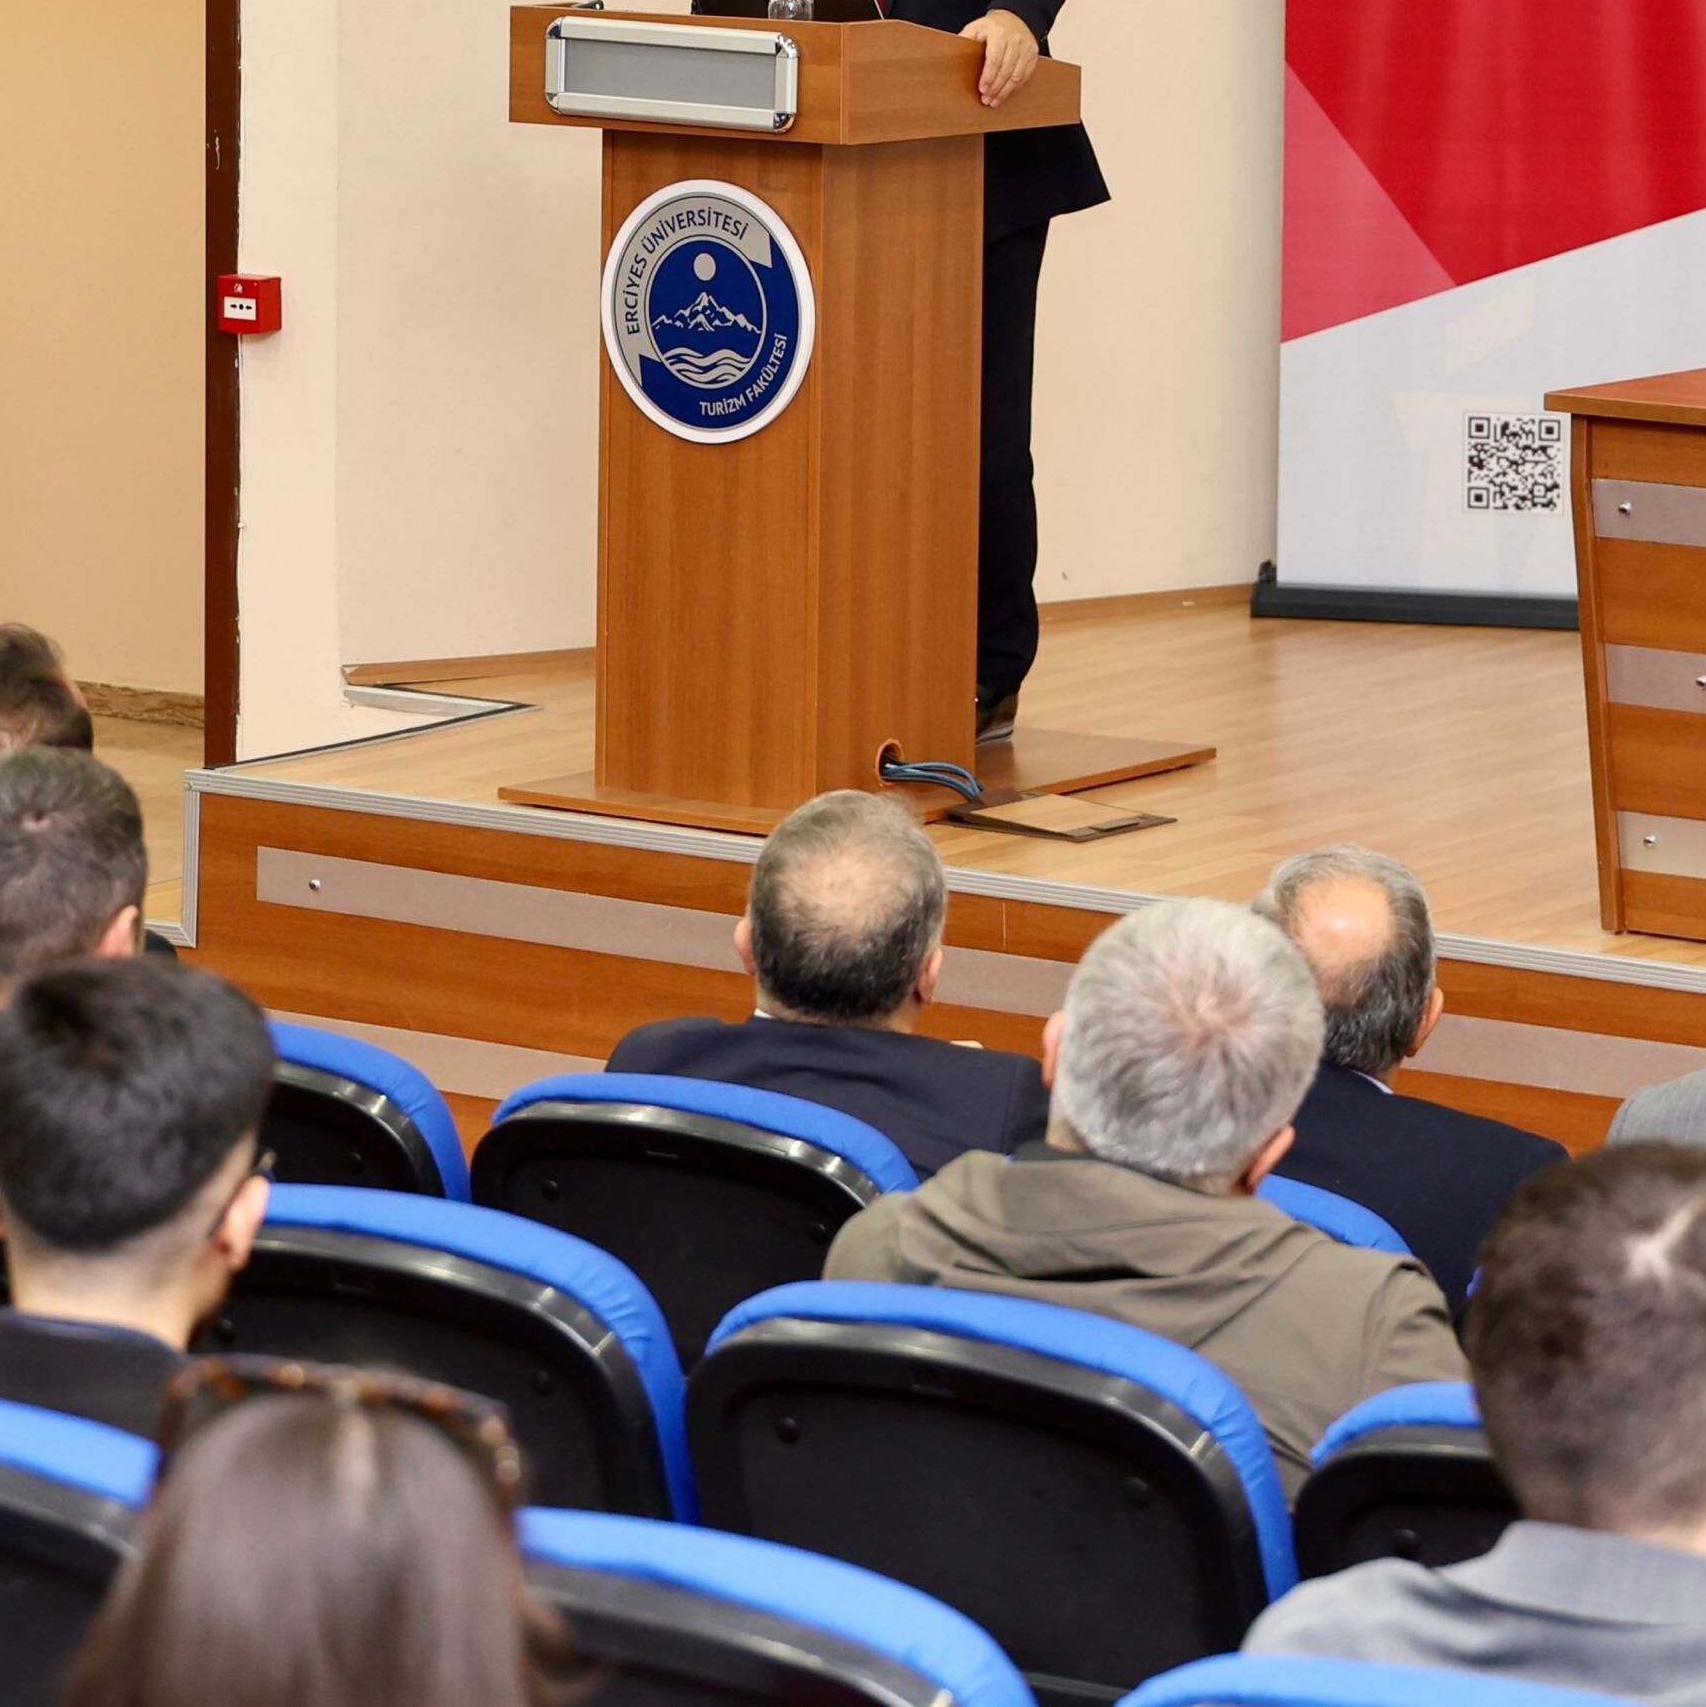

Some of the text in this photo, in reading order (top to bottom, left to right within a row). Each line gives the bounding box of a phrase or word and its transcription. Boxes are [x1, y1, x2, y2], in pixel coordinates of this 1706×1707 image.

[622, 206, 749, 335] ERCİYES ÜNİVERSİTESİ
[699, 333, 787, 416] TURİZM FAKÜLTESİ
